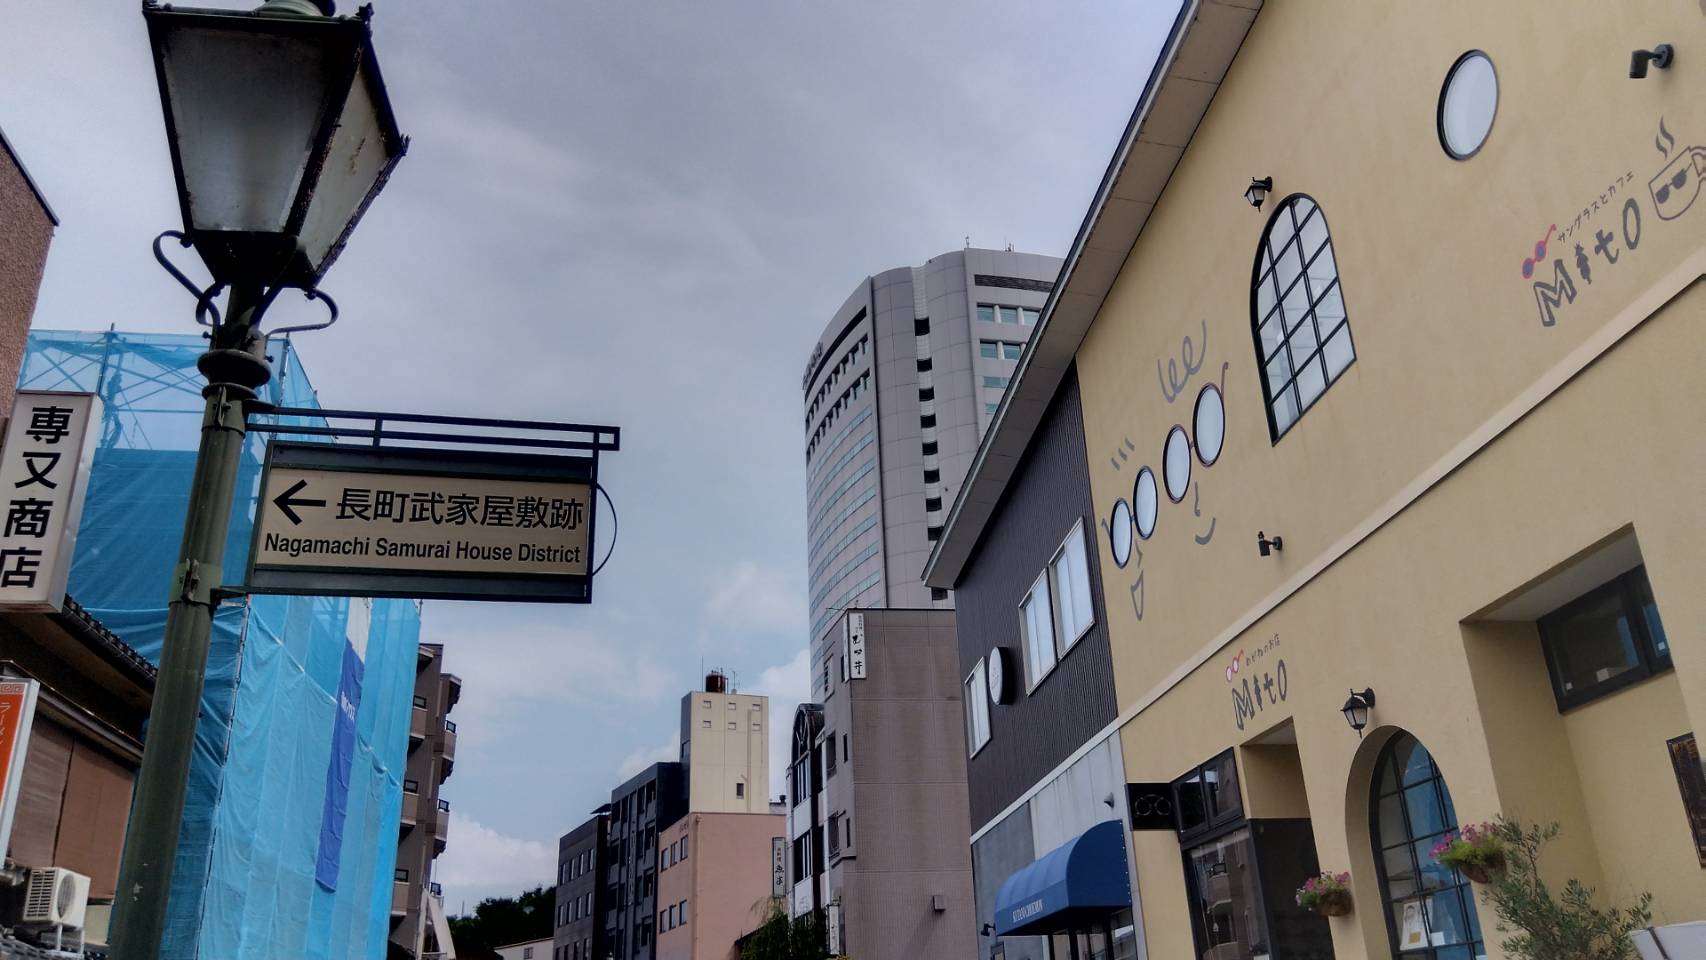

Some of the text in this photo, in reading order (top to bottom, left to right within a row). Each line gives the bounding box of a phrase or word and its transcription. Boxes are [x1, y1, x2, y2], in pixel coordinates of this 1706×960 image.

[1557, 170, 1635, 243] サングラスとカフェ
[0, 405, 74, 589] 専又商店
[335, 487, 584, 531] 長町武家屋敷跡
[265, 532, 581, 563] Nagamachi Samurai House District
